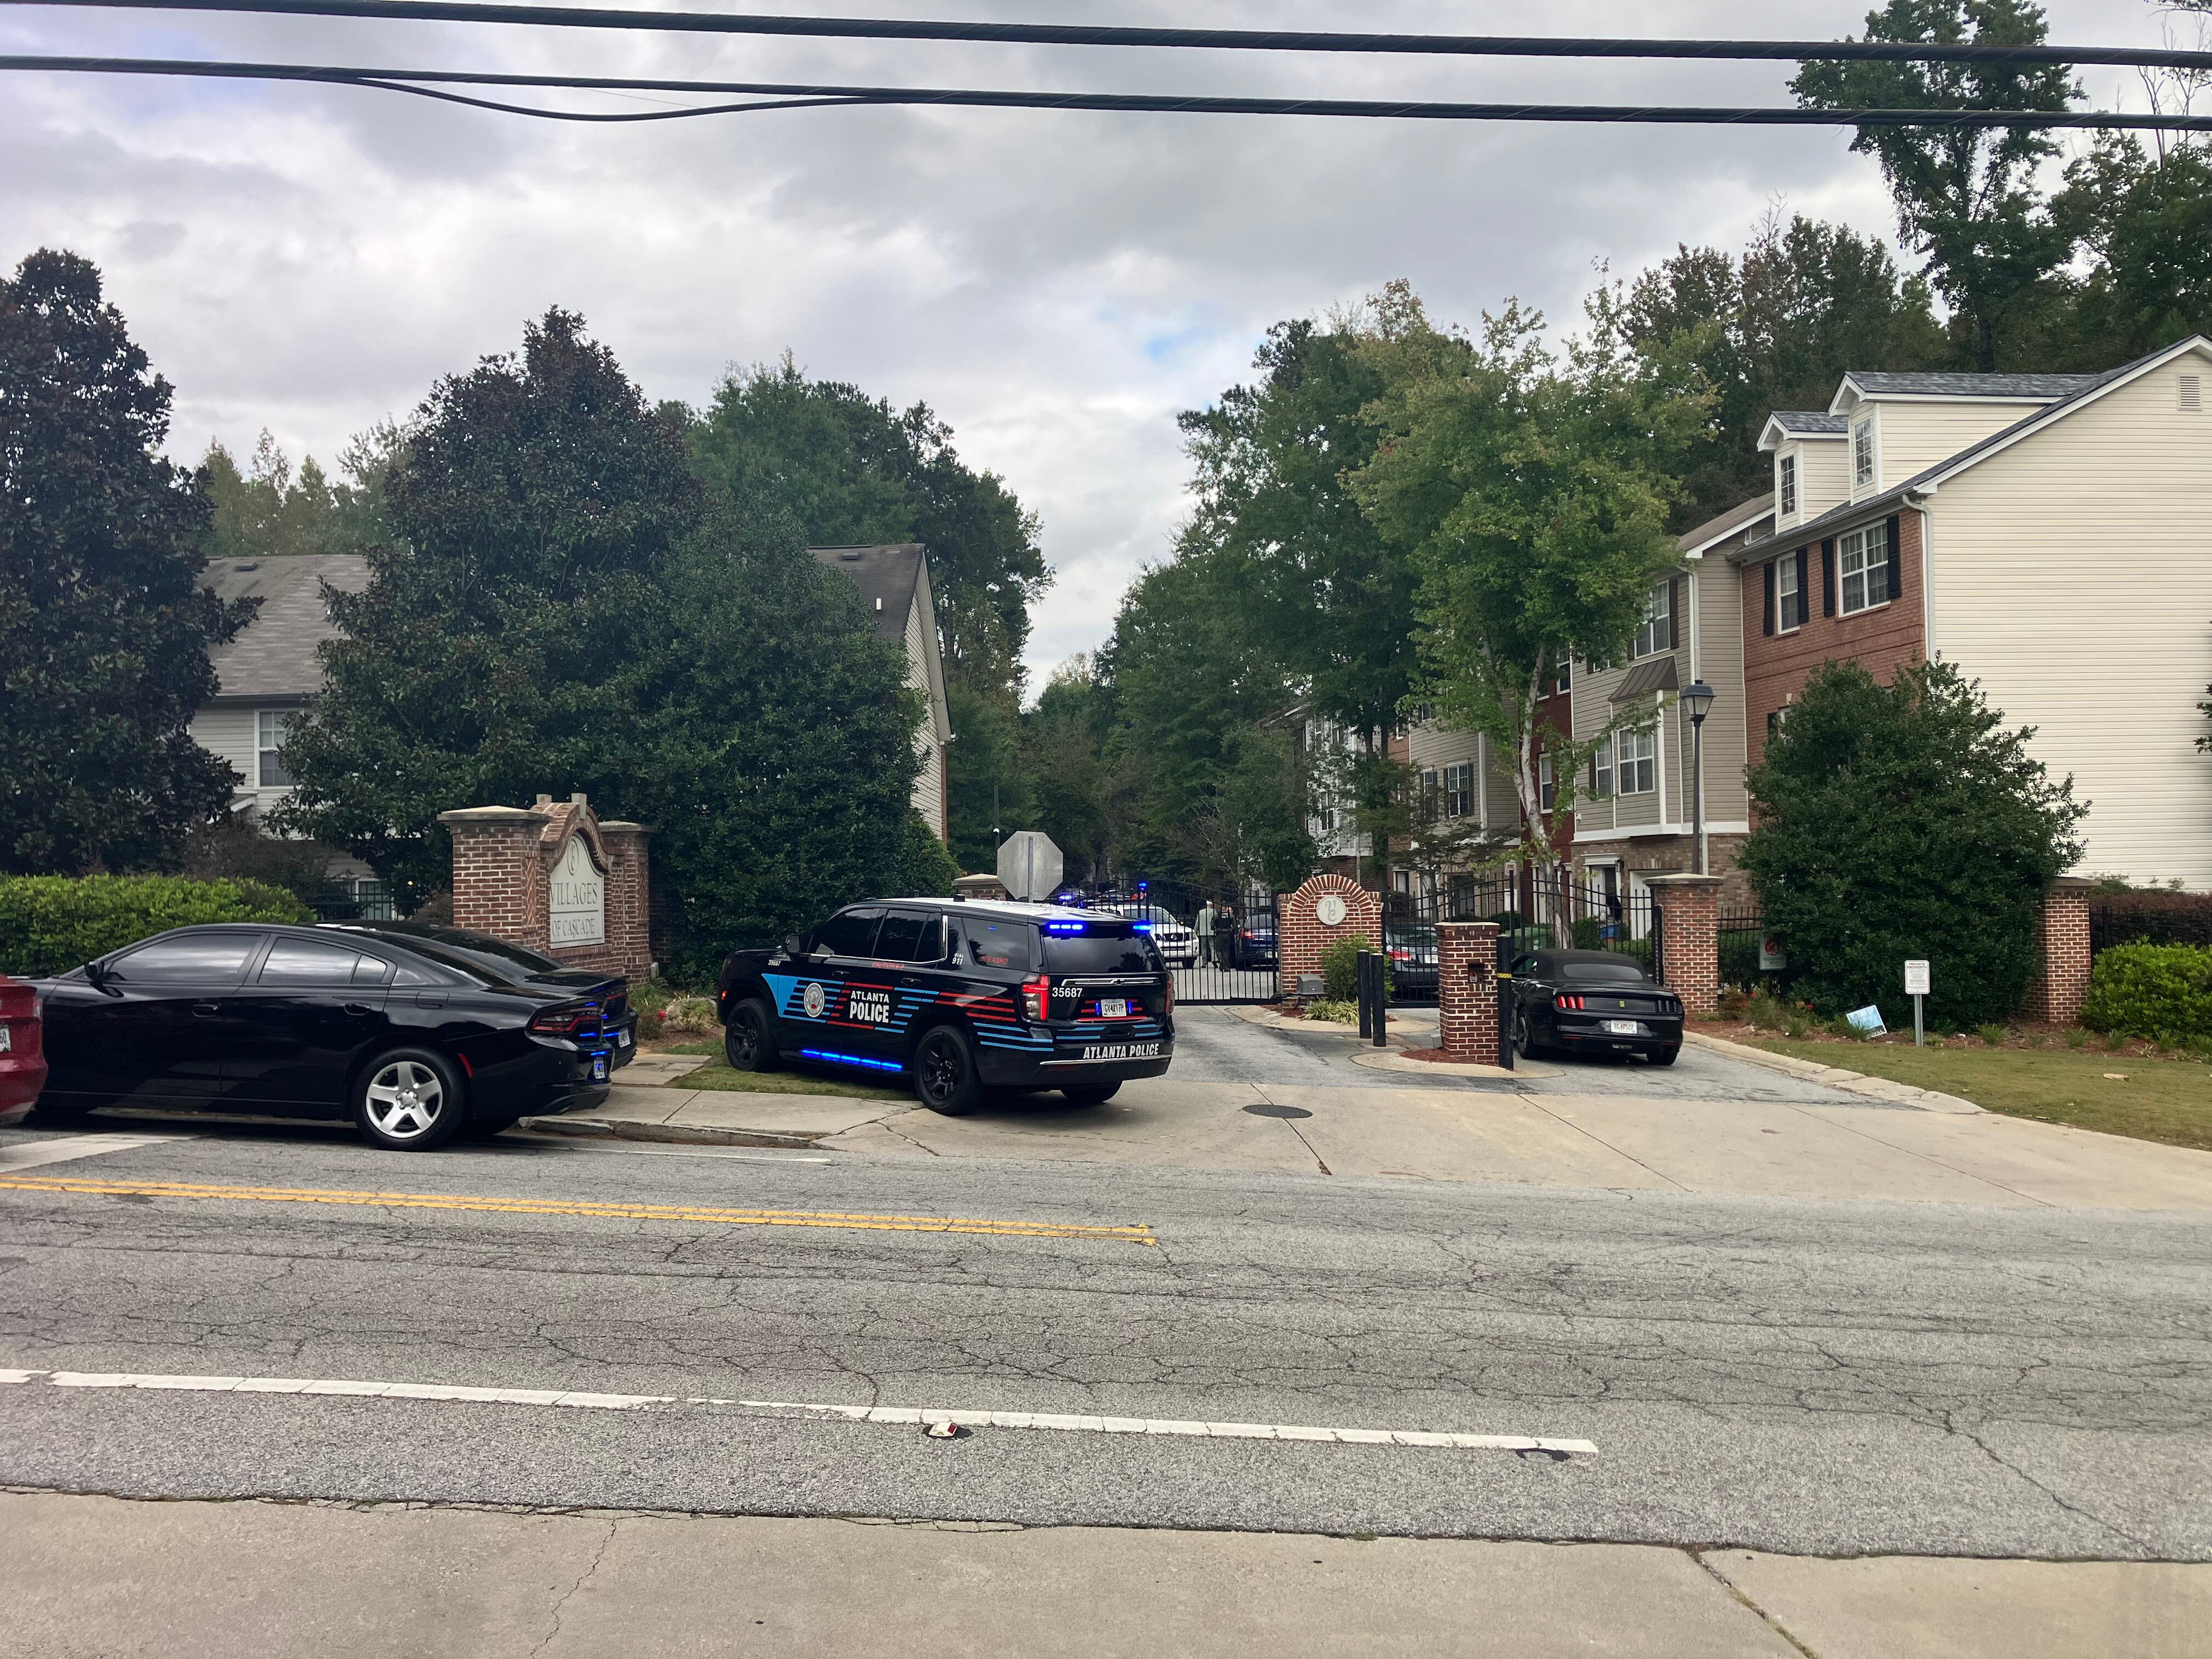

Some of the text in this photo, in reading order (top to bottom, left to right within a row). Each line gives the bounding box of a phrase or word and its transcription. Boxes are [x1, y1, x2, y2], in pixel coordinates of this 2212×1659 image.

[550, 882, 597, 905] VILLAGES
[552, 918, 595, 938] OF CASCADE
[850, 990, 890, 1003] ATLANTA
[1052, 987, 1083, 997] 35687
[849, 1001, 890, 1023] POLICE
[1082, 1043, 1159, 1059] ATLANTA POLICE
